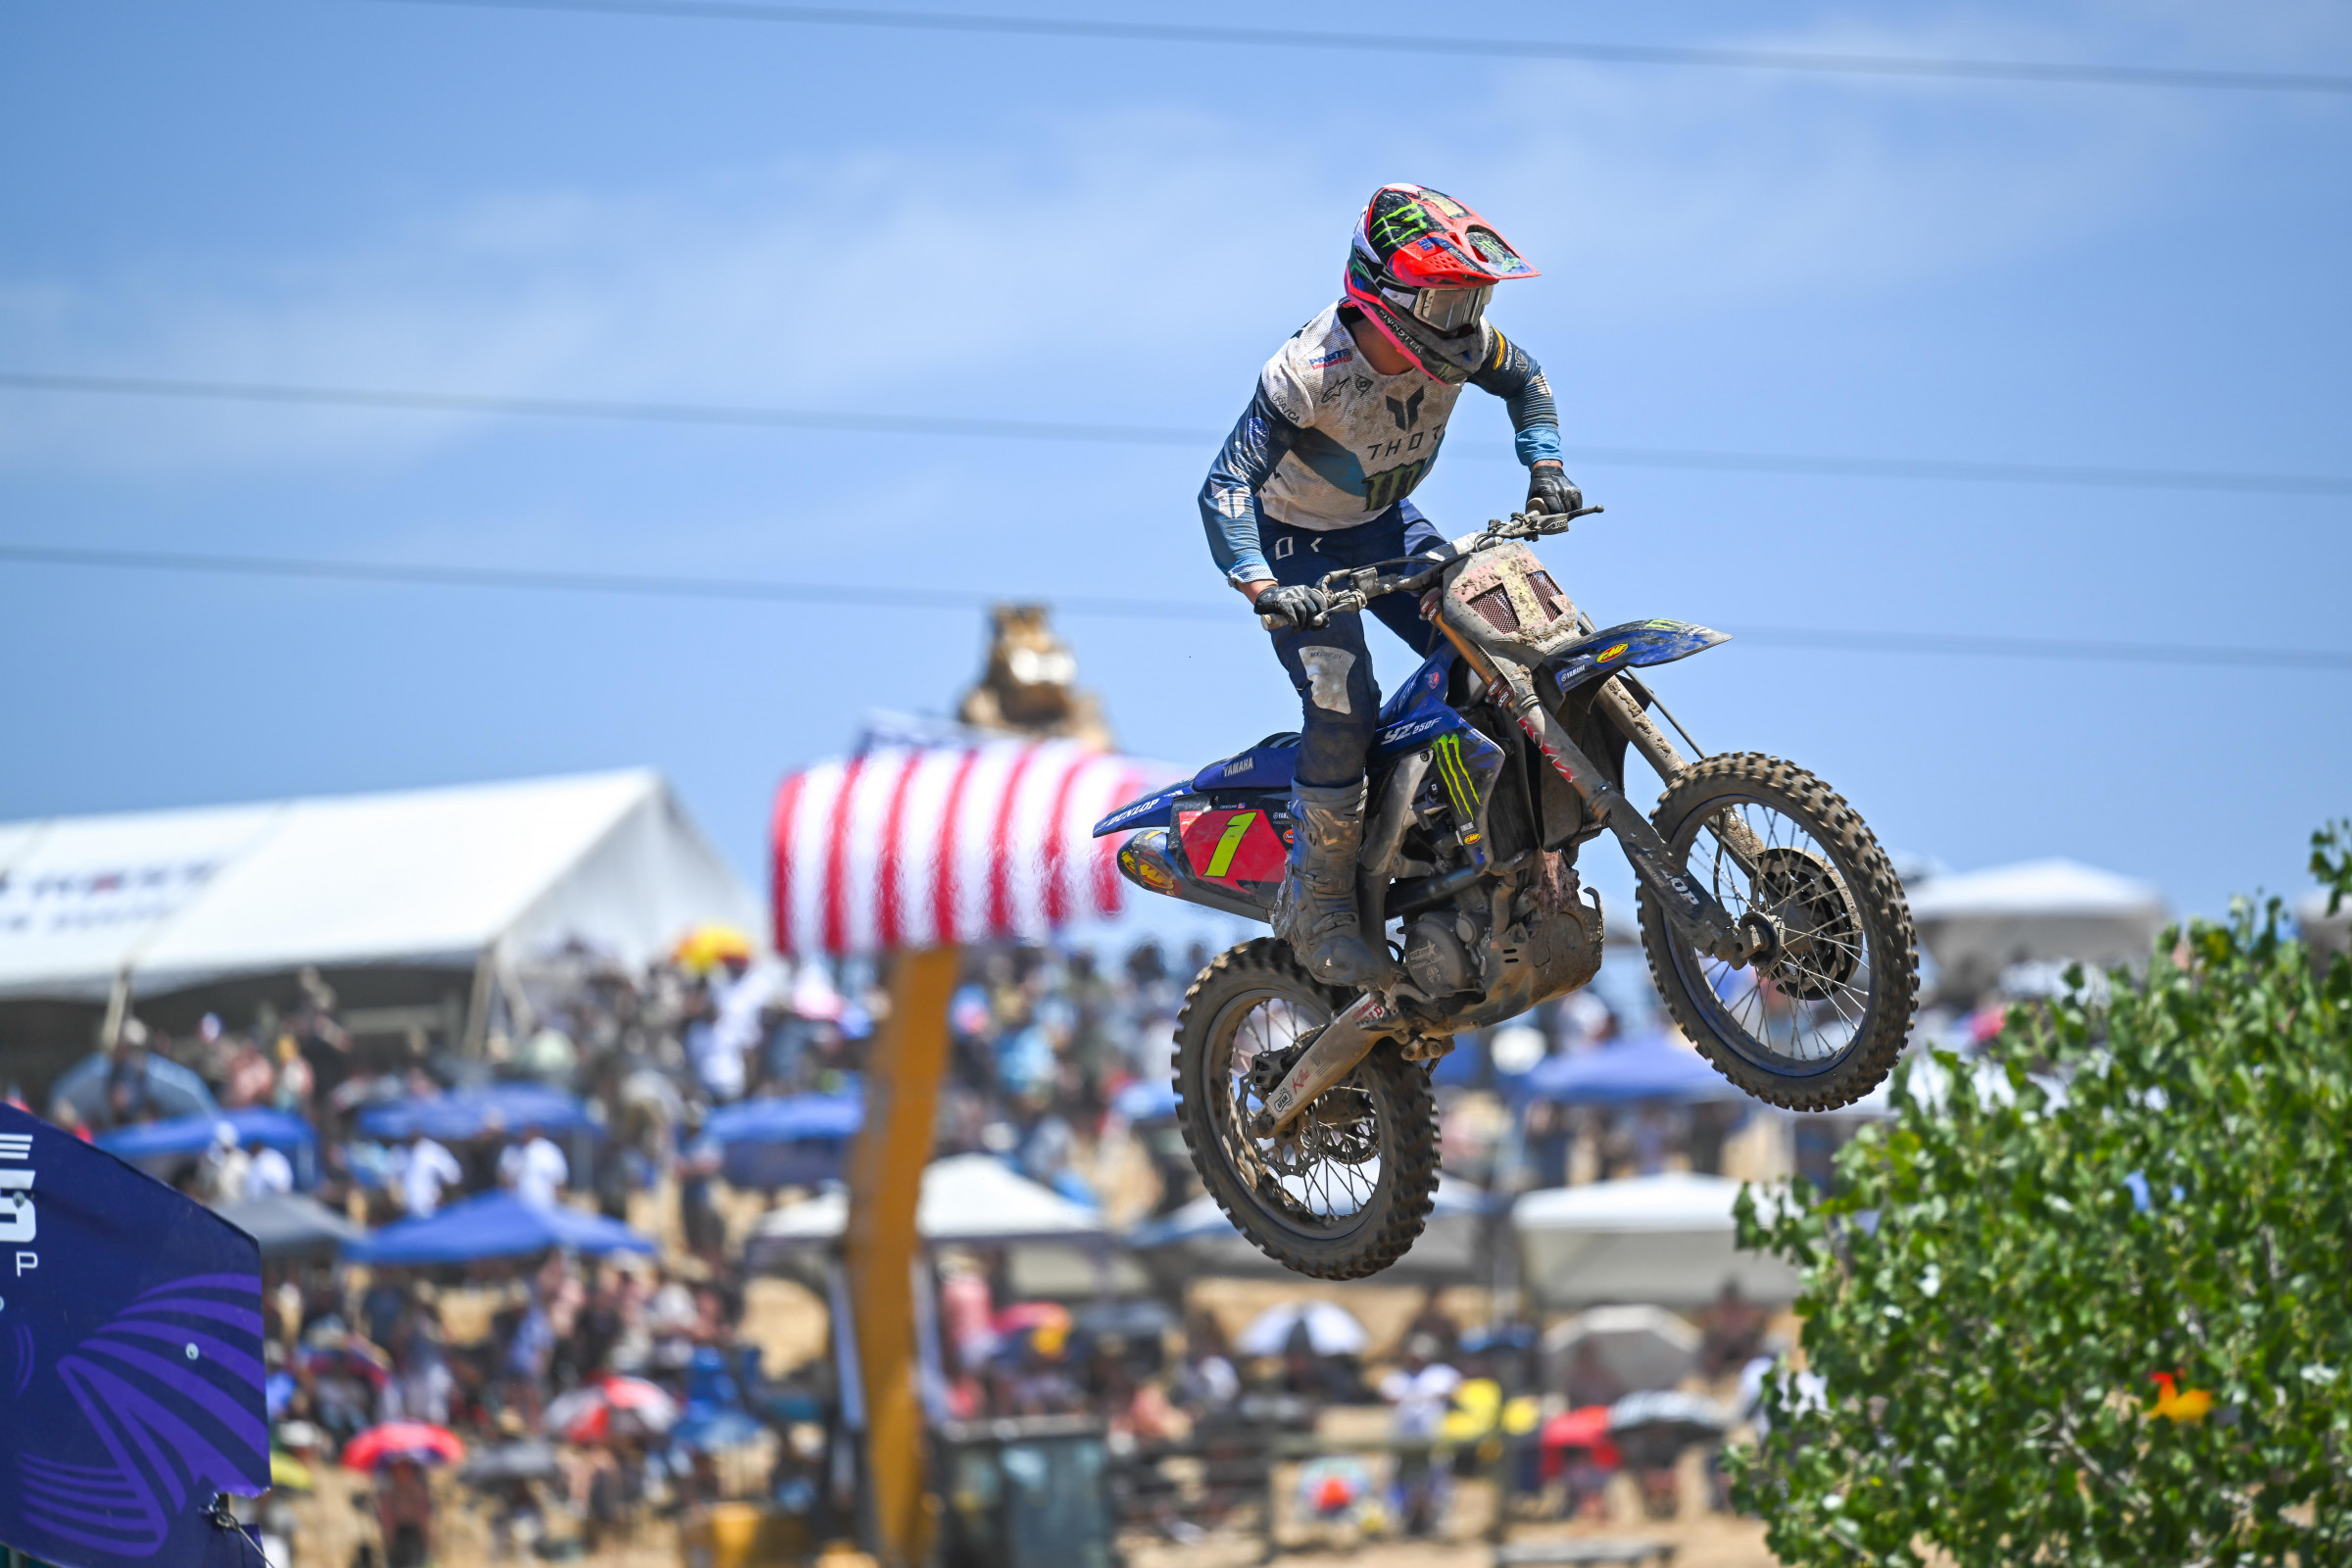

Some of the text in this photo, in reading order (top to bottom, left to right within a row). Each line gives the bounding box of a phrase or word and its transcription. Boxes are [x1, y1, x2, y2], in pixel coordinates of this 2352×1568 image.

[1272, 393, 1300, 424] USA/CA
[1596, 643, 1629, 663] FMF
[1566, 663, 1586, 678] YAMAHA
[1381, 716, 1443, 746] YZ 250F
[1223, 758, 1253, 777] YAMAHA
[1105, 799, 1160, 827] DUNLOP
[1201, 811, 1257, 877] 1
[1277, 1095, 1289, 1108] AFAM
